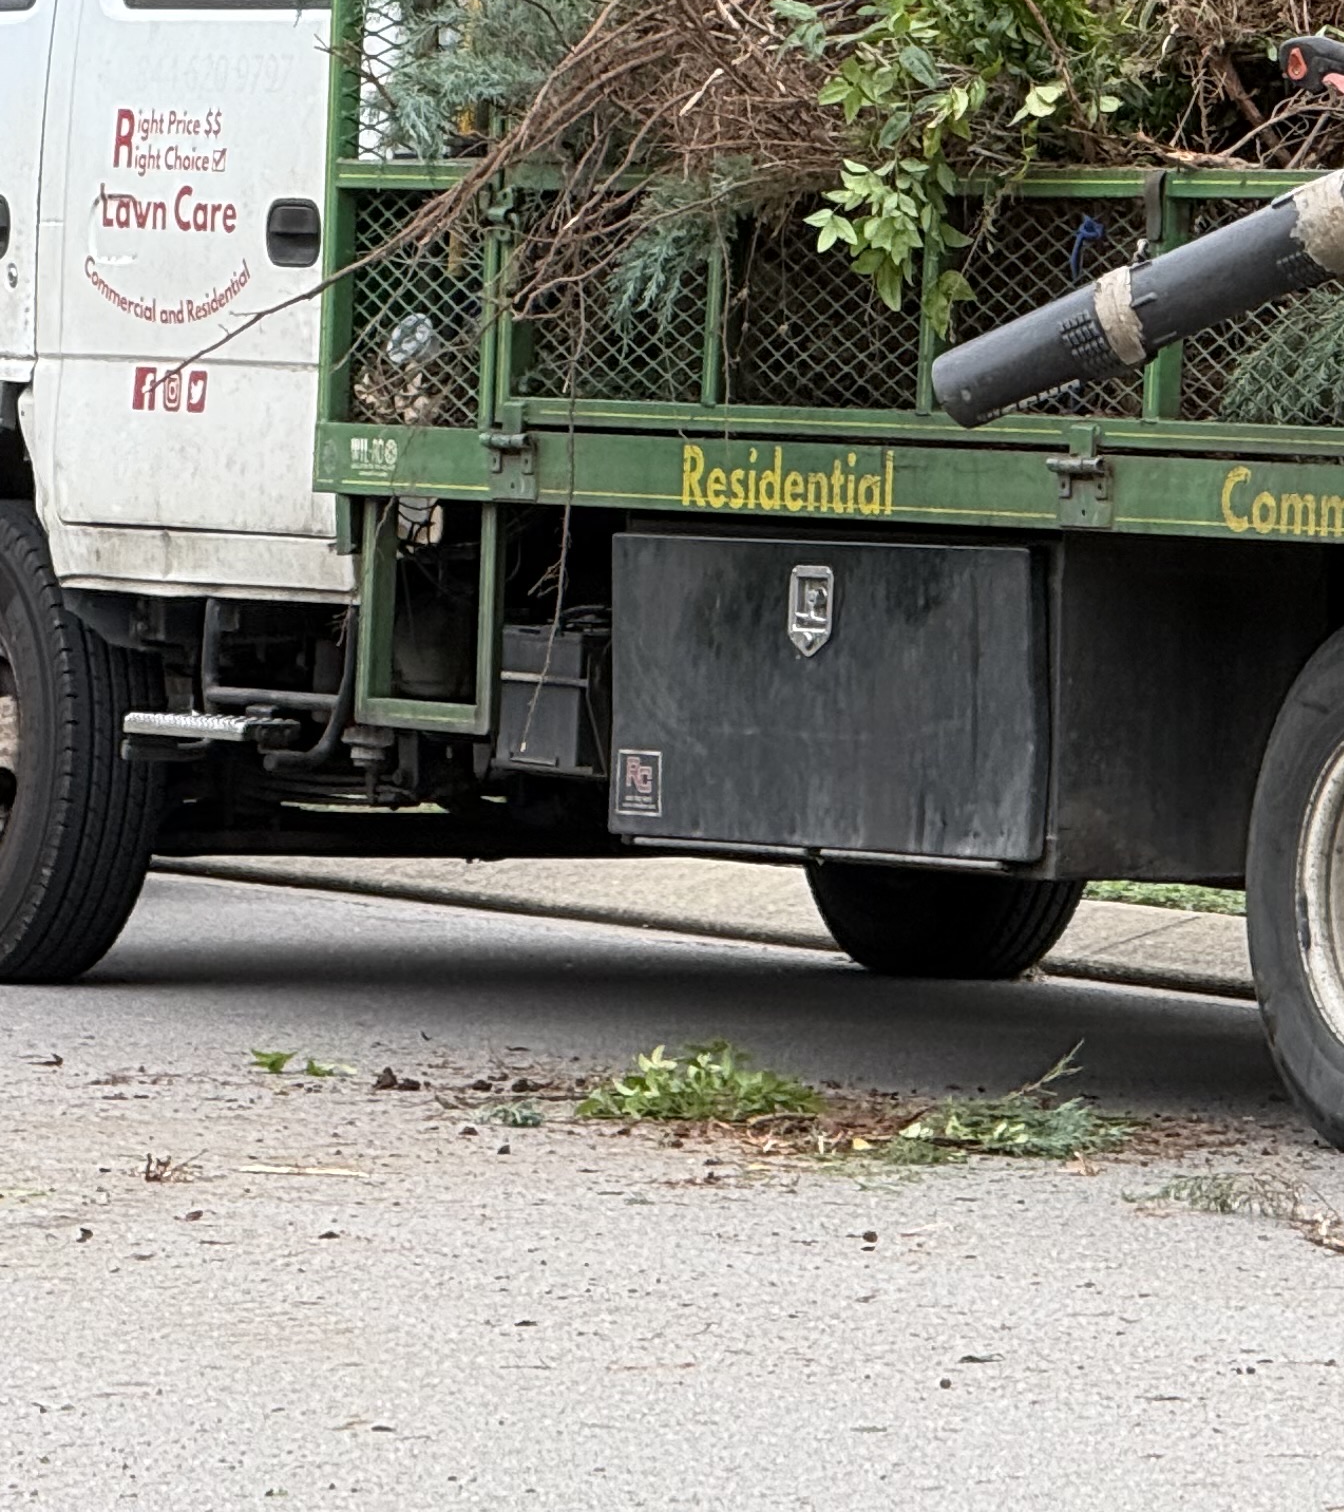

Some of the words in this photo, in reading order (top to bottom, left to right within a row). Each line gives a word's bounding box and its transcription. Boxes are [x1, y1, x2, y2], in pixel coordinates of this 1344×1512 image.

[167, 110, 201, 135] Price
[204, 107, 222, 138] $$
[164, 145, 210, 172] Choice
[101, 185, 167, 230] Lawn
[174, 185, 238, 233] Care
[84, 255, 157, 322] Commercial
[160, 299, 184, 325] and
[187, 258, 251, 323] Residential
[682, 444, 895, 515] Residential
